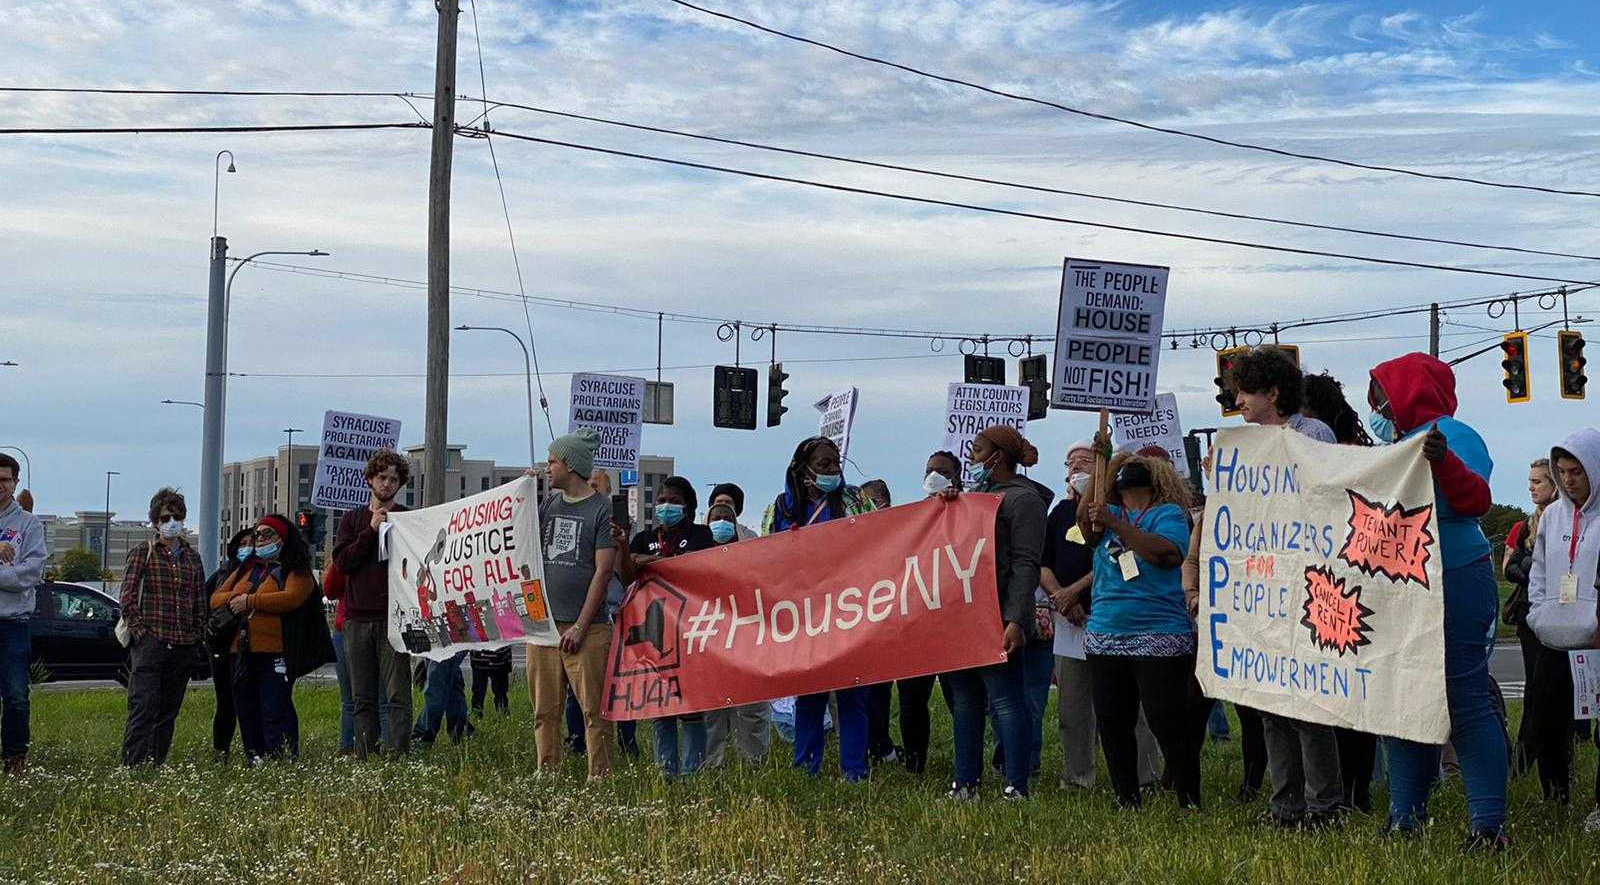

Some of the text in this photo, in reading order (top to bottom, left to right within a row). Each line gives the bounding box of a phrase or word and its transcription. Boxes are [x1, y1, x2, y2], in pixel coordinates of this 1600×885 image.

[1075, 270, 1158, 294] THE PEOPLE
[1085, 291, 1144, 311] DEMAND:
[1075, 308, 1151, 333] HOUSE
[1068, 340, 1150, 365] PEOPLE
[580, 379, 636, 396] SYRACUSE
[1063, 366, 1150, 397] NOT FISH!
[573, 394, 641, 410] PROLETARIANS
[954, 399, 1022, 413] LEGISLATORS
[955, 387, 1023, 401] ATTN COUNTY
[333, 415, 391, 435] SYRACUSE
[574, 408, 638, 424] AGAINST
[1115, 409, 1175, 428] PEOPLE'S
[324, 430, 396, 449] PROLETARIANS
[577, 423, 633, 437] PAYER-
[1126, 423, 1168, 440] NEEDS
[324, 444, 377, 461] AGAIN
[331, 475, 371, 489] FUNDE
[1215, 448, 1300, 496] HOUSIN
[317, 485, 372, 503] AQUARIU
[447, 496, 513, 535] HOUSING
[1214, 505, 1333, 559] ORGANIZERS
[445, 525, 516, 564] JUSTICE
[443, 556, 519, 594] FOR ALL
[1209, 556, 1287, 618] PEOPLE
[683, 538, 986, 655] #HouseNY
[1314, 582, 1345, 616] CANCEL
[1317, 604, 1353, 636] RENT!
[1210, 613, 1372, 700] EMPOWERMENT
[608, 675, 683, 712] HJ4A
